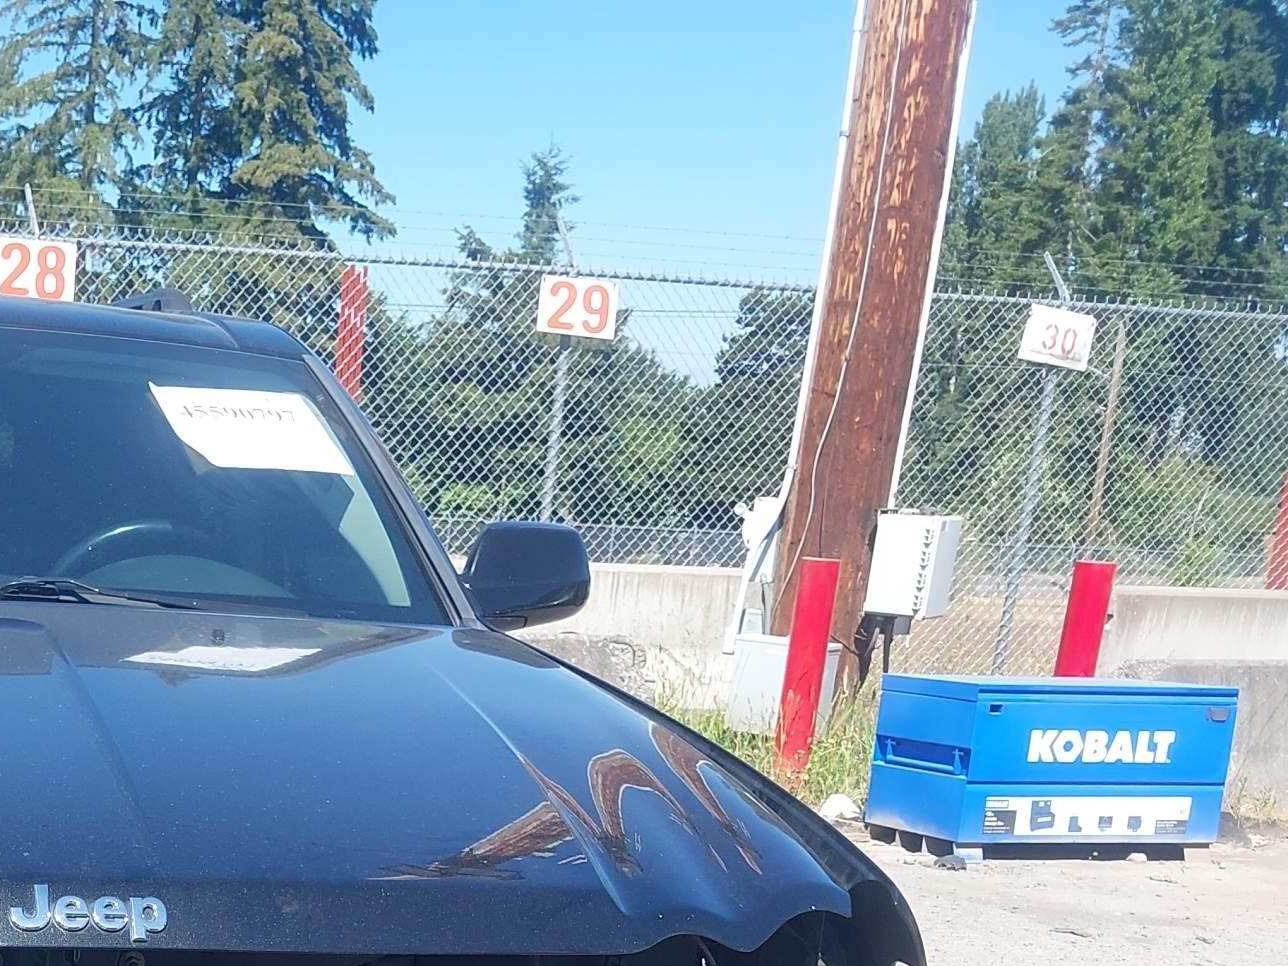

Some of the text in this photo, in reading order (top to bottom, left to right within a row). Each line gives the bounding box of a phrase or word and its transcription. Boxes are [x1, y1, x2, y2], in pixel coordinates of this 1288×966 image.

[0, 243, 66, 299] 28
[547, 281, 610, 334] 29
[1041, 323, 1078, 356] 30
[1027, 729, 1176, 764] KOBALT
[9, 884, 168, 943] Jeep
